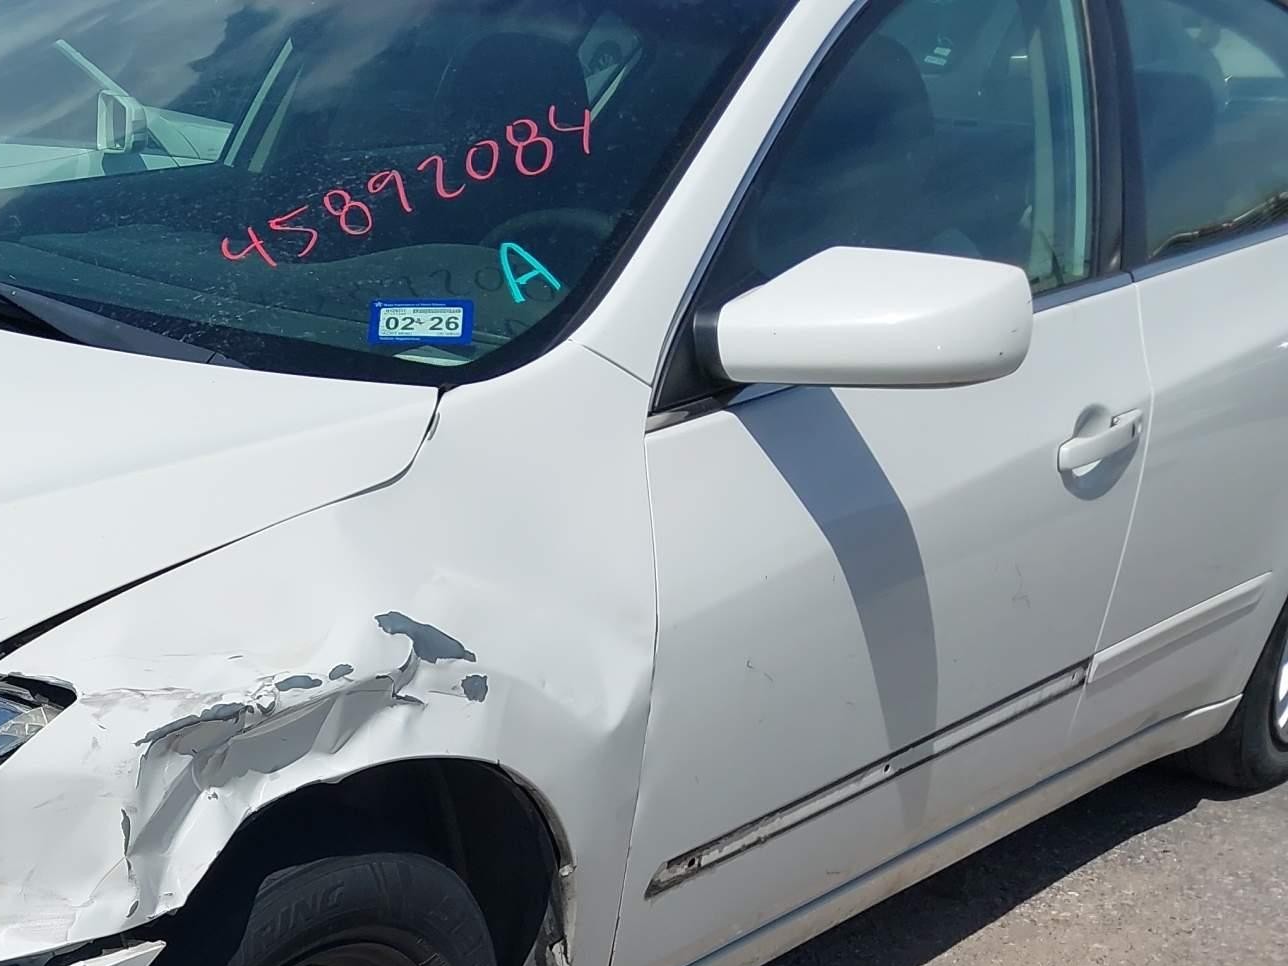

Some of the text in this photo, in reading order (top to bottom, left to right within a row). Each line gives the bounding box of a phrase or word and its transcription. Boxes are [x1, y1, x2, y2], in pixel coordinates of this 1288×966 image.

[220, 105, 593, 268] 45892084
[499, 242, 562, 303] A
[385, 316, 459, 331] 02 26
